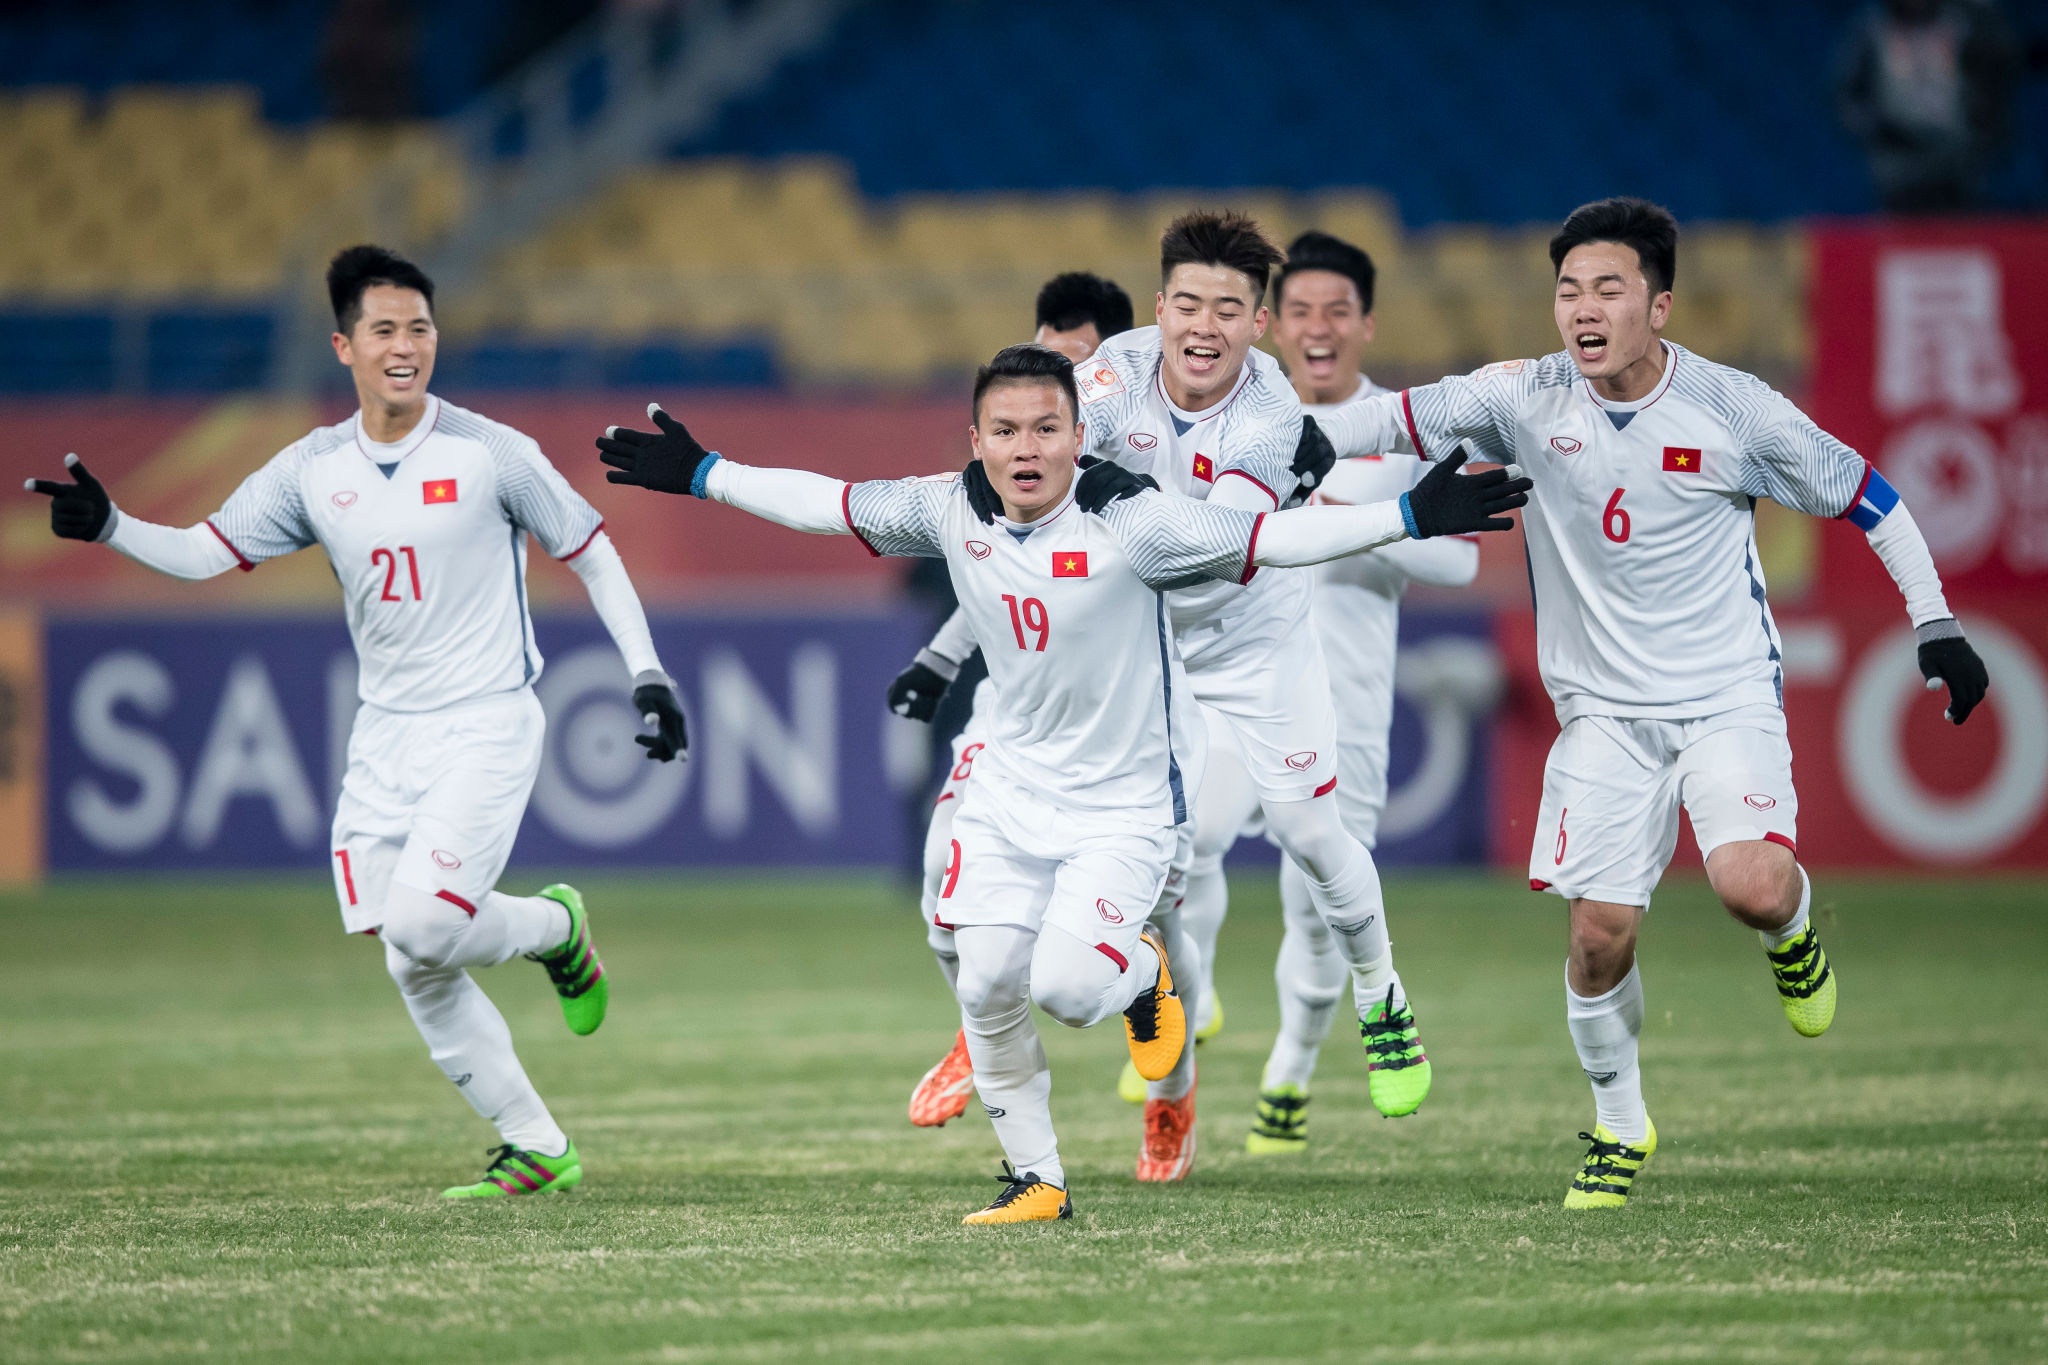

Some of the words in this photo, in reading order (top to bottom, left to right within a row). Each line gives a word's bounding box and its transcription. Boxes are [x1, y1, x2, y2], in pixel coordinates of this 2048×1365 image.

[1602, 487, 1631, 543] 6
[371, 546, 422, 602] 21
[1002, 594, 1050, 652] 19
[952, 743, 985, 780] 8
[1554, 807, 1568, 866] 6
[335, 849, 358, 905] 1
